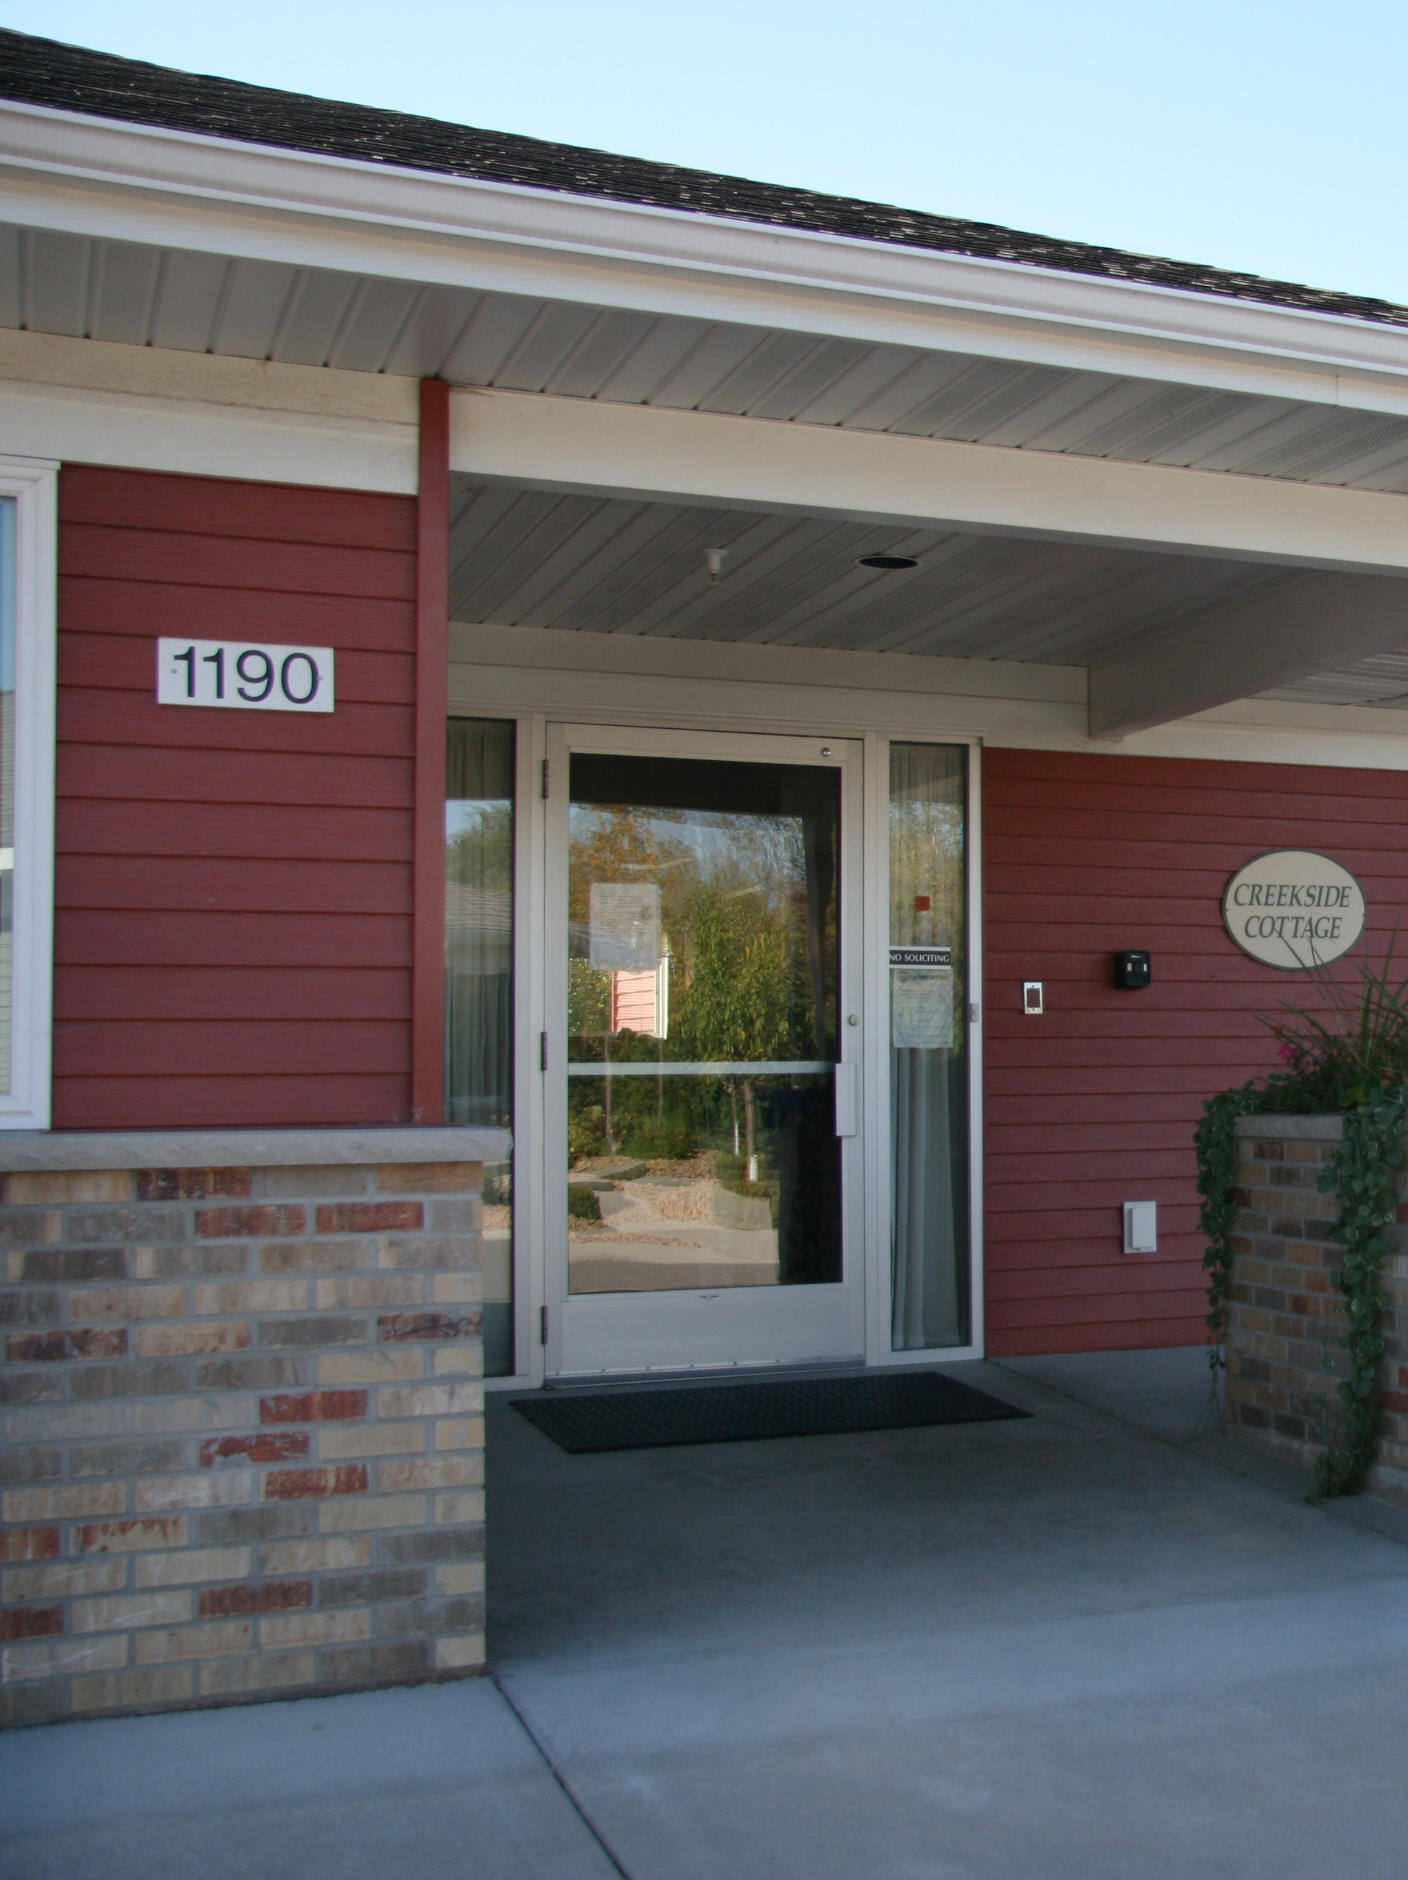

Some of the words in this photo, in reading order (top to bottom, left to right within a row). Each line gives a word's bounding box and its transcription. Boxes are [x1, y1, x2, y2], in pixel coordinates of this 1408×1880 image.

[173, 646, 320, 705] 1190
[1233, 883, 1352, 908] CREEKSIDE
[1244, 915, 1343, 939] COTTAGE
[889, 953, 902, 962] NO
[904, 953, 950, 962] SOLICITING
